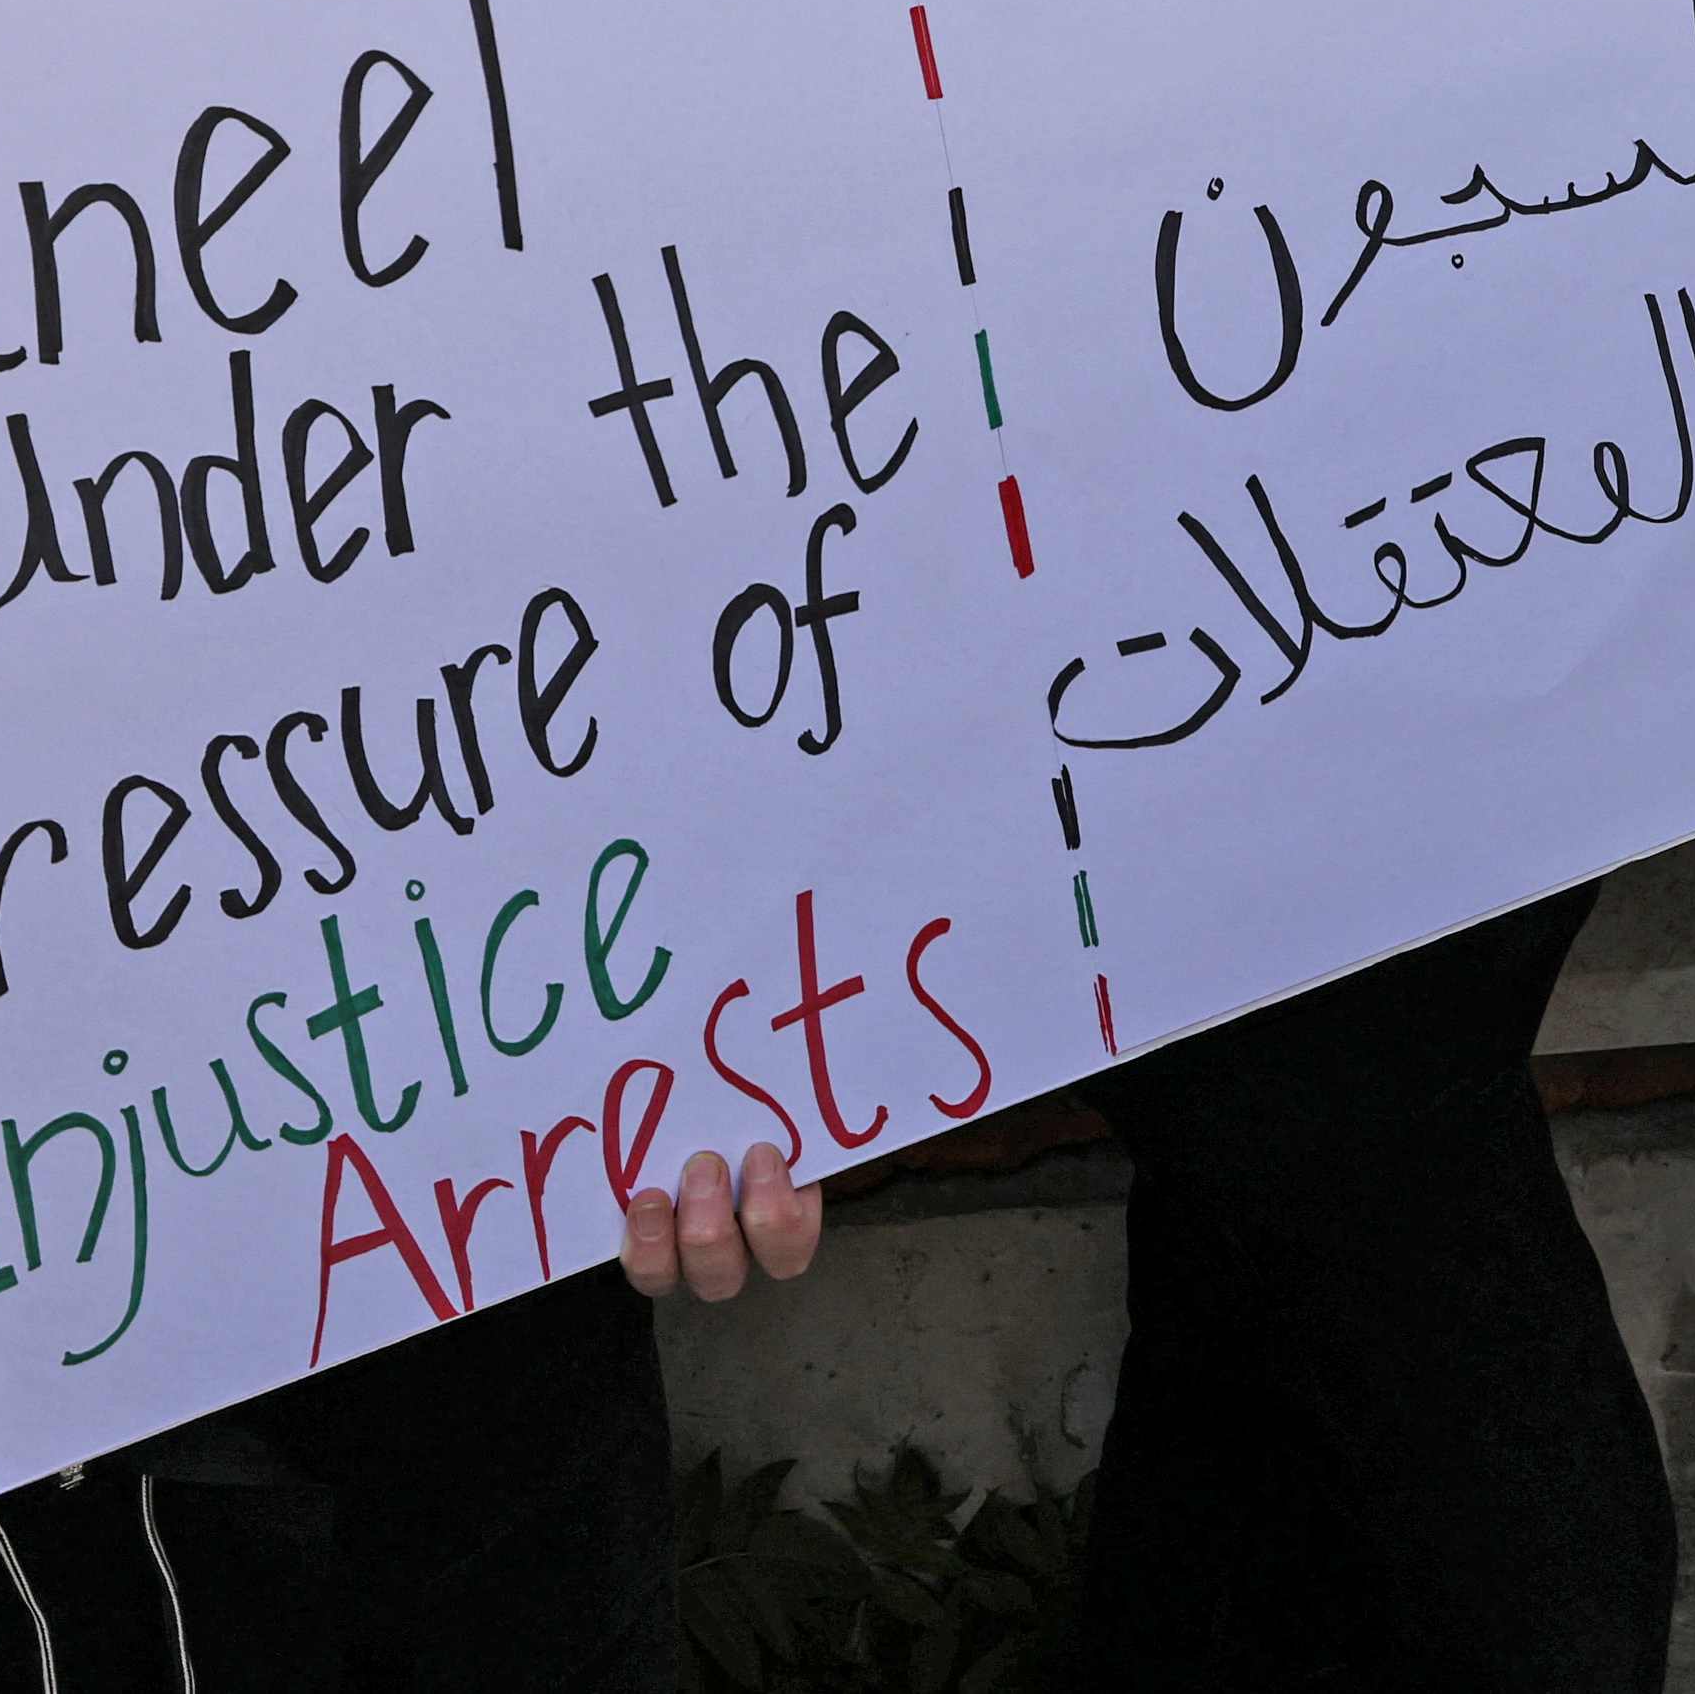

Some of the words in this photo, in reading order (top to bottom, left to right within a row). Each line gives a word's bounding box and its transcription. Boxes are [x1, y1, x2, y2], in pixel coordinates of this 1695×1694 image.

[588, 245, 919, 508] the
[713, 503, 860, 756] of
[309, 889, 992, 1369] Arrests
